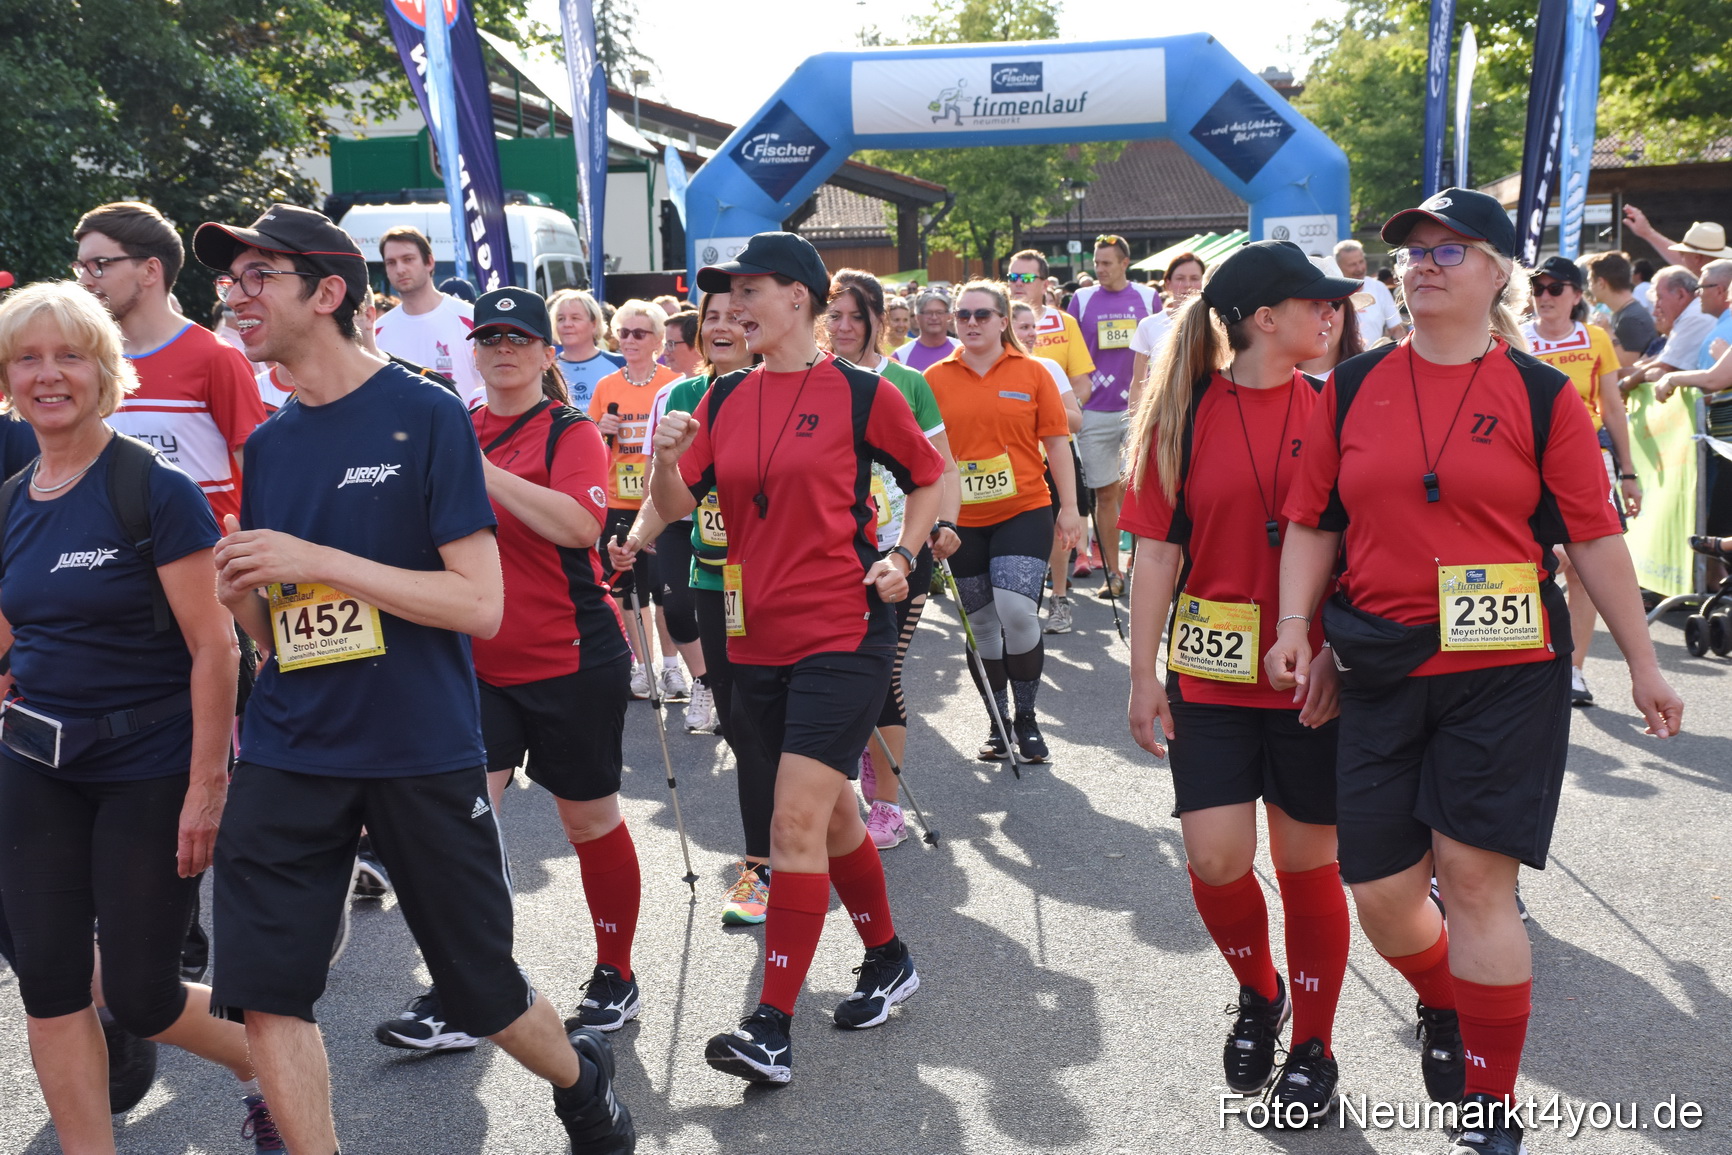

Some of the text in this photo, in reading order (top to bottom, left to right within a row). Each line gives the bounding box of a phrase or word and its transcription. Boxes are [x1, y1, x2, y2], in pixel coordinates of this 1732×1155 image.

[1001, 73, 1040, 83] Fischer
[973, 91, 1088, 117] firmenlauf
[973, 117, 1020, 125] neumarkt
[1211, 125, 1228, 136] und
[1229, 122, 1247, 132] das
[754, 142, 815, 157] Fischer
[759, 156, 810, 164] AUTOMOBILE
[1107, 330, 1129, 341] 884
[1560, 352, 1593, 364] BÖGL
[796, 414, 819, 431] 79
[1471, 413, 1498, 436] 77
[337, 466, 381, 489] JURA
[965, 471, 1008, 492] 1795
[50, 551, 98, 573] JURA
[1457, 580, 1503, 590] firmenlauf
[1454, 594, 1530, 626] 2351
[280, 599, 363, 643] 1452
[1213, 621, 1231, 630] walk
[1451, 626, 1537, 637] Meyerhöfer Constanze
[293, 637, 349, 653] Strobl Oliver
[1178, 623, 1243, 660] 2352
[287, 651, 316, 662] Lebenshilfe
[316, 646, 347, 656] Neumarkt
[1180, 652, 1238, 669] Meyerhöfer Mona
[1190, 663, 1237, 675] Handelsgesellschaft
